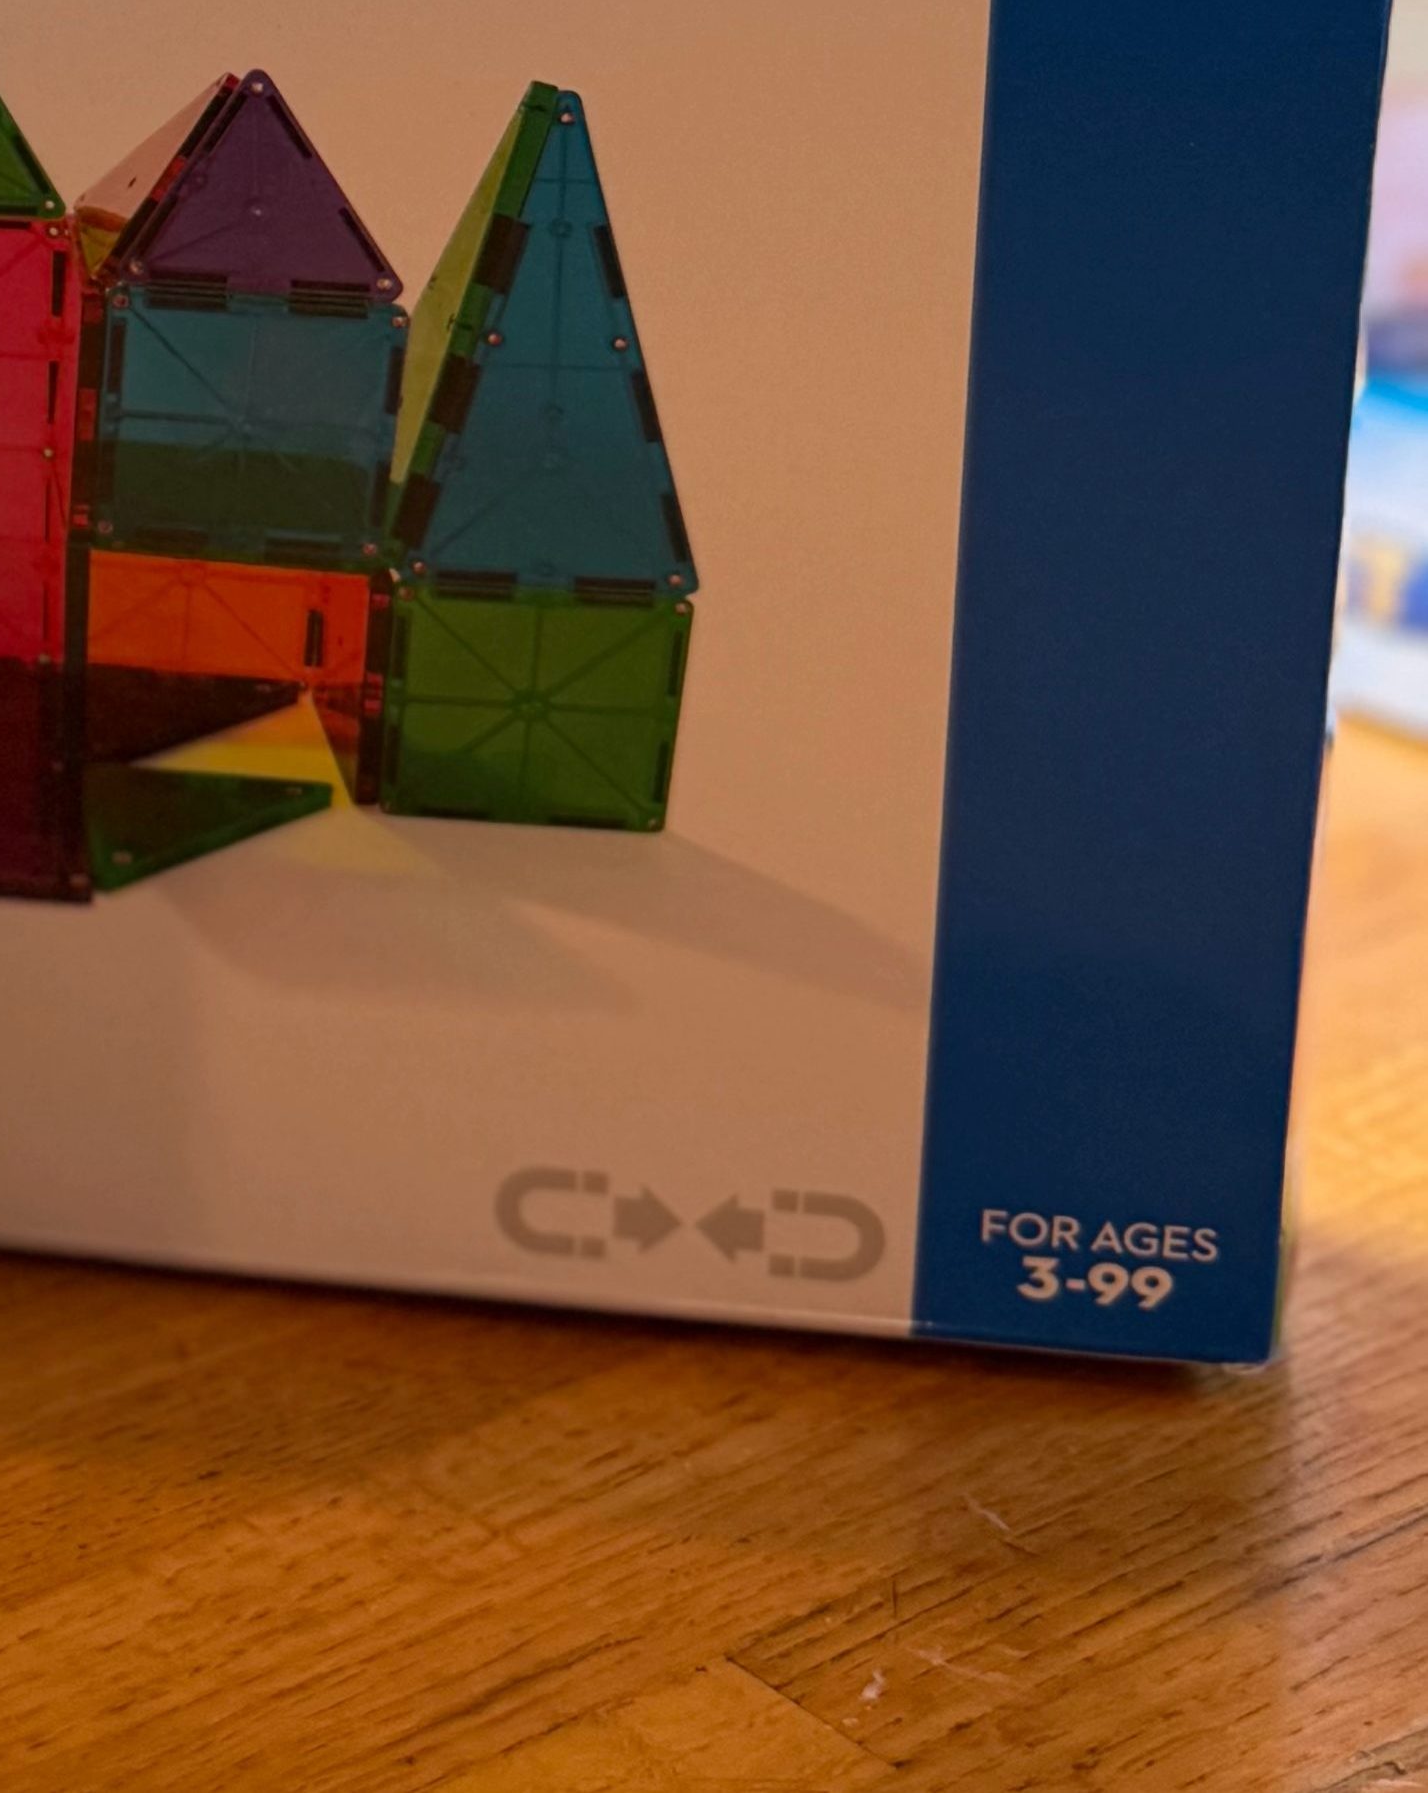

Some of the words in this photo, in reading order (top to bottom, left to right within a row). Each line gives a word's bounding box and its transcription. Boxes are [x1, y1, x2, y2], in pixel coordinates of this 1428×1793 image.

[981, 1209, 1079, 1250] FOR
[1091, 1221, 1218, 1262] AGES
[1017, 1256, 1173, 1309] 3-99
